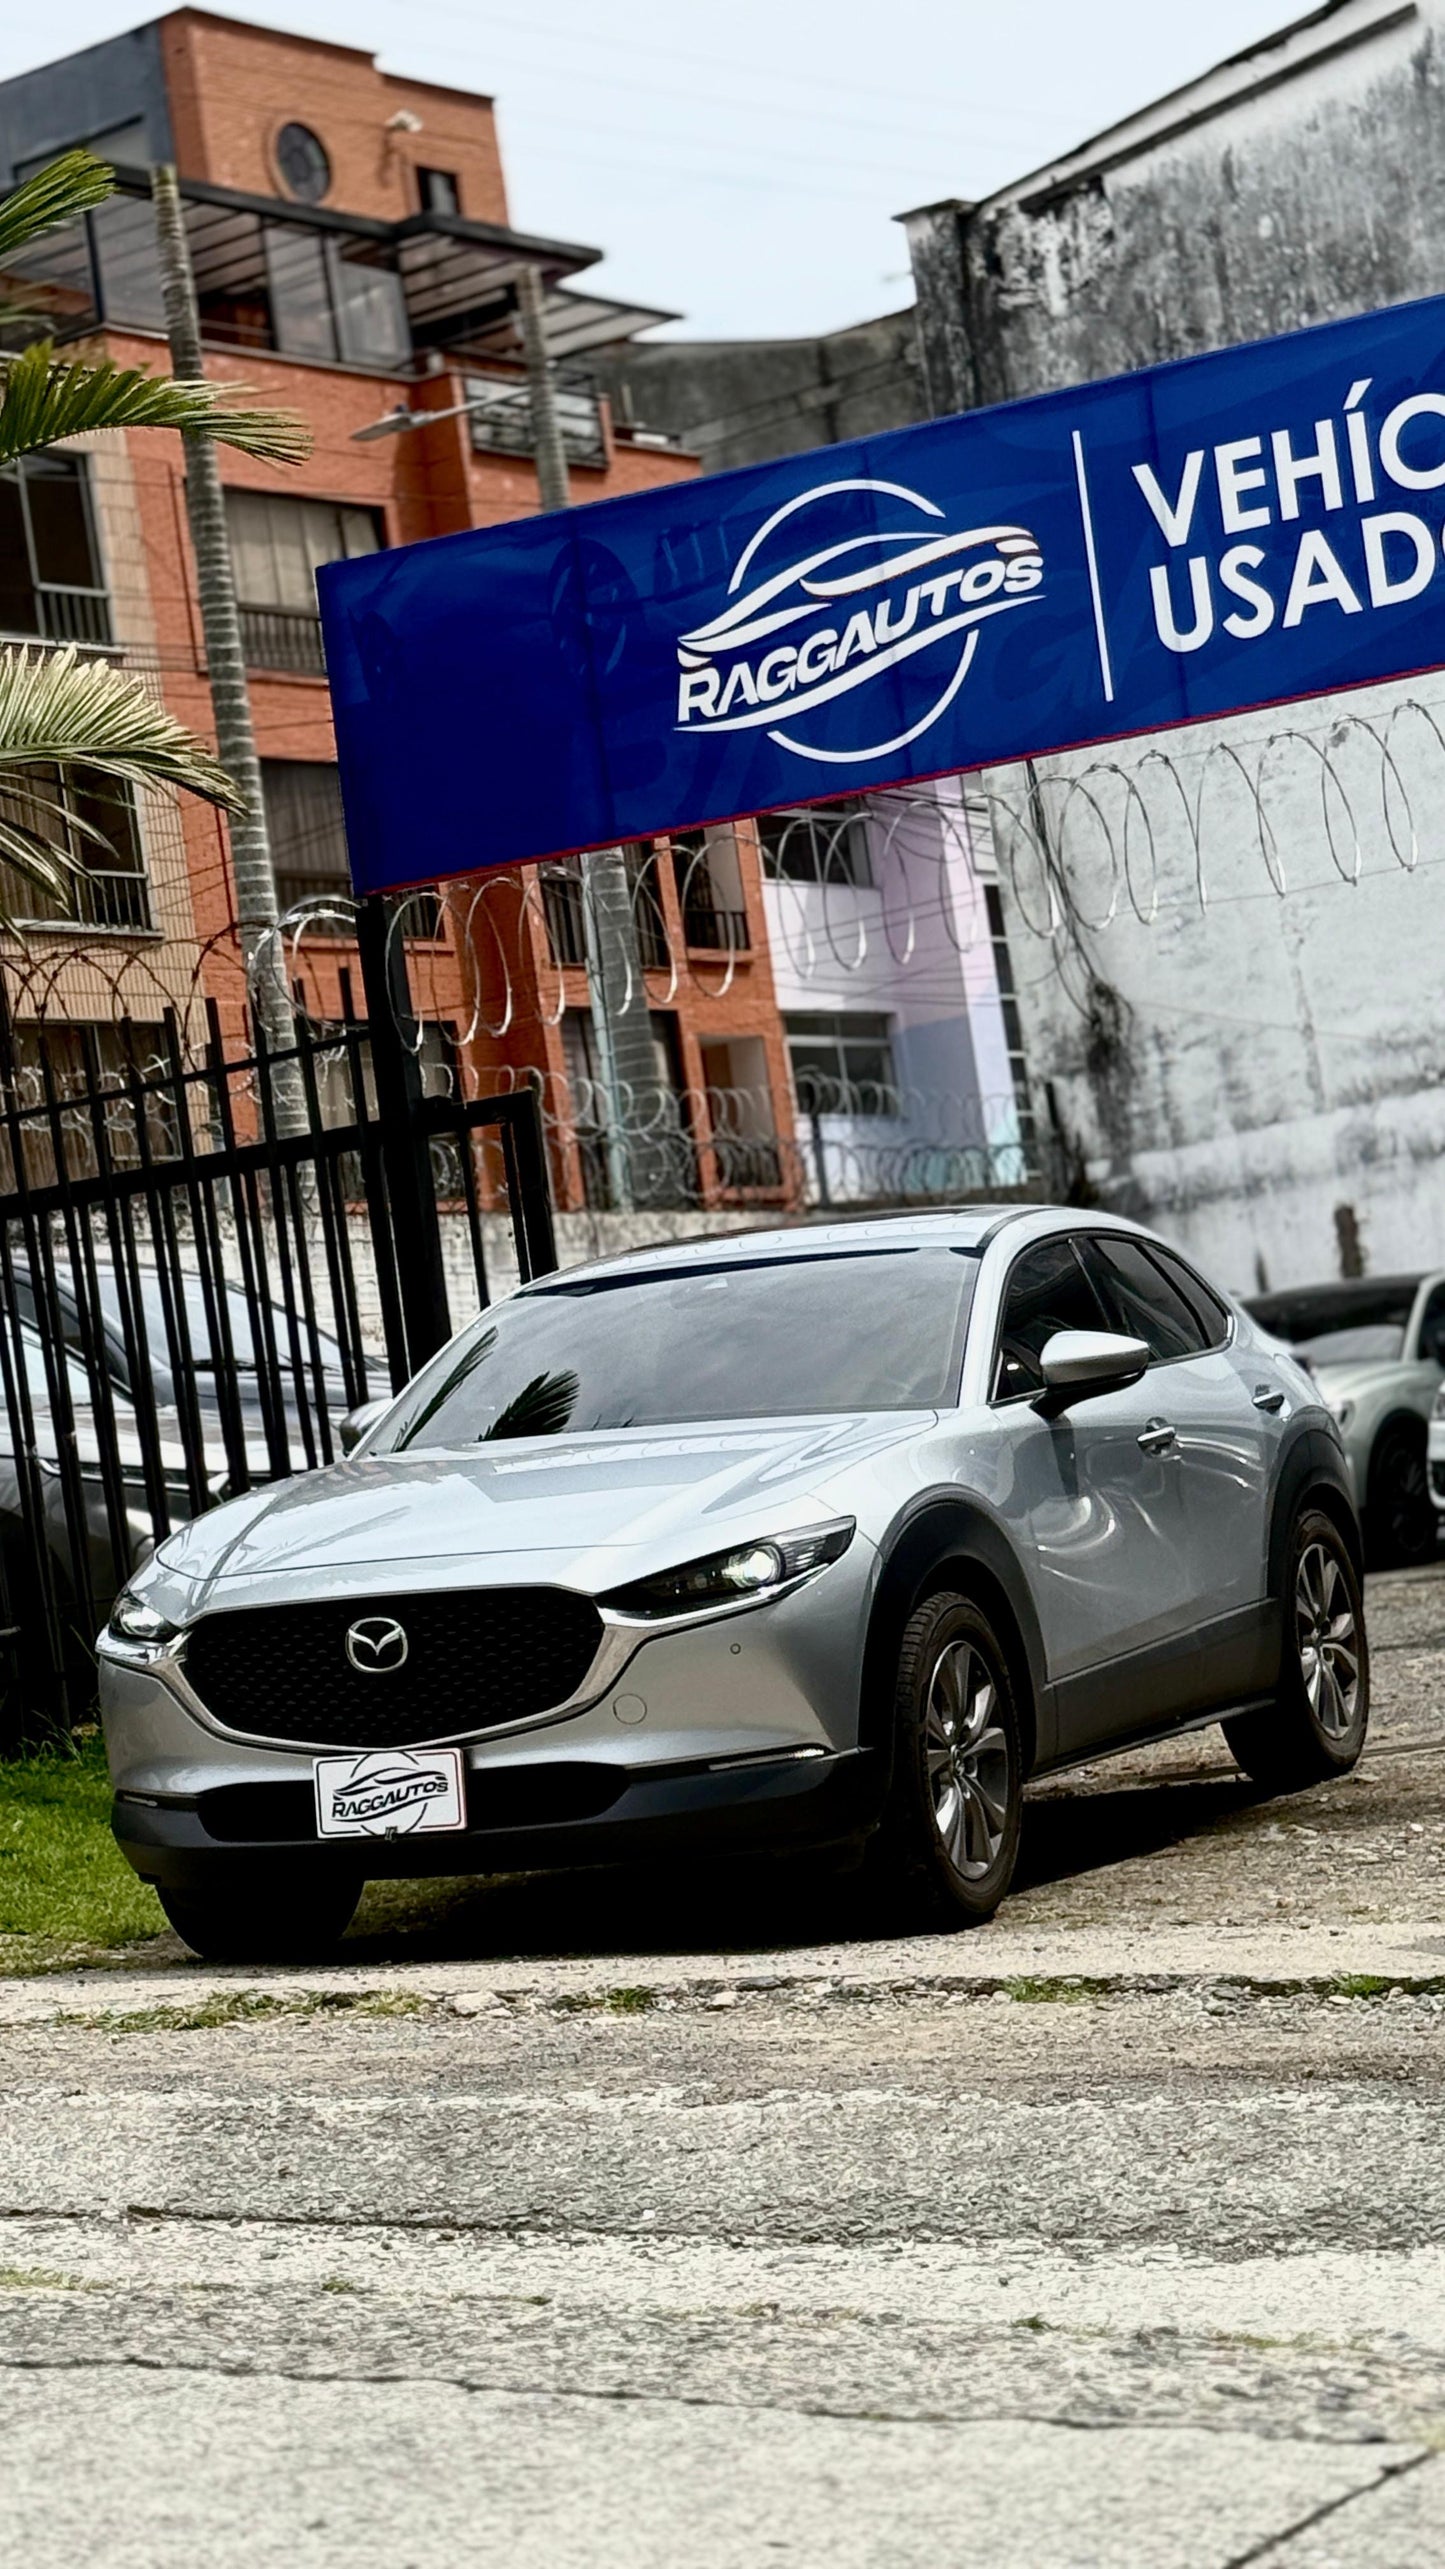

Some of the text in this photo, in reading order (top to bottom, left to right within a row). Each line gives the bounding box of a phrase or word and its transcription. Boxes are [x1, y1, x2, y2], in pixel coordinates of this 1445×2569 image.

[677, 556, 1044, 723] RAGGAUTOS
[1149, 511, 1445, 653] USAD
[331, 1781, 449, 1818] RAGGAUTOS
